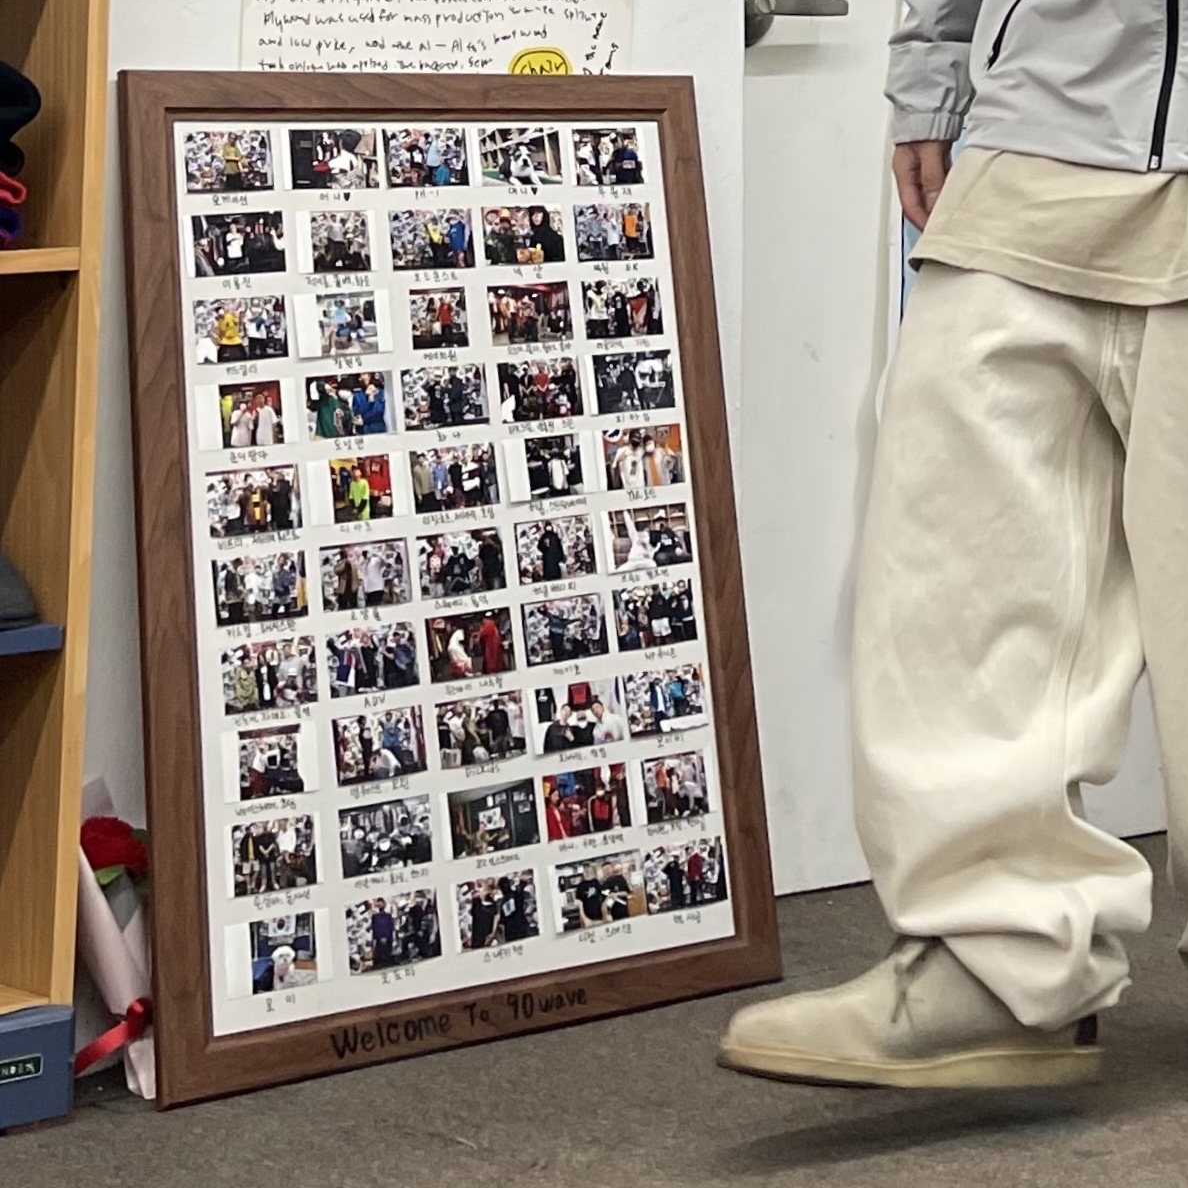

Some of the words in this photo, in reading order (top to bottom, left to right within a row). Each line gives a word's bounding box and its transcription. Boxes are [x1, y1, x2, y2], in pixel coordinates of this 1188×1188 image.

[364, 693, 386, 709] ADV
[330, 1014, 450, 1059] Welcome
[464, 1002, 490, 1026] To
